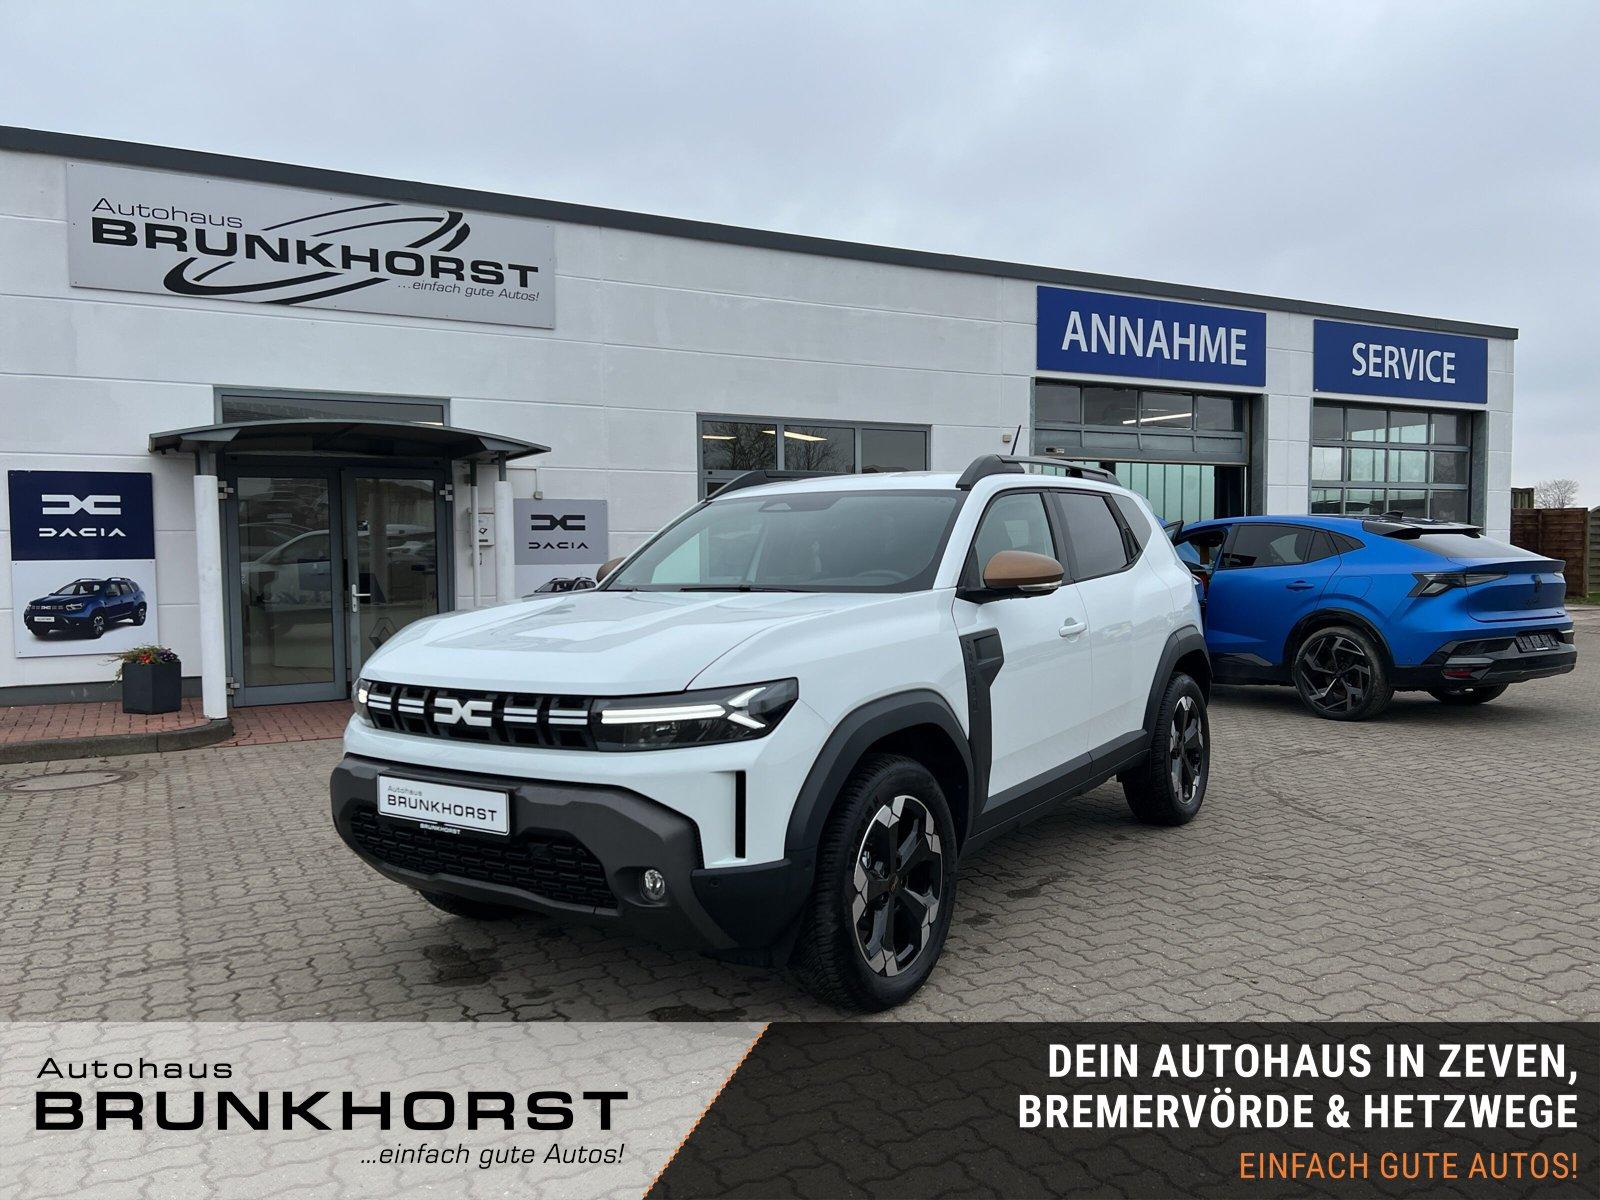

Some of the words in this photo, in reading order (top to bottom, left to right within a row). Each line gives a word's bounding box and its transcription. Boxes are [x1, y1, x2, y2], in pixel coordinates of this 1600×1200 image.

[92, 197, 243, 229] Autohaus
[91, 216, 539, 288] BRUNKHORST
[465, 286, 495, 297] gute
[498, 288, 540, 302] Autos!
[1062, 311, 1247, 365] ANNAHME
[1352, 342, 1456, 384] SERVICE
[38, 527, 126, 538] DACIA
[528, 541, 589, 550] DACIA
[387, 785, 422, 796] Autohaus
[387, 795, 497, 821] BRUNKHORST
[419, 823, 461, 834] BRUNKHORST
